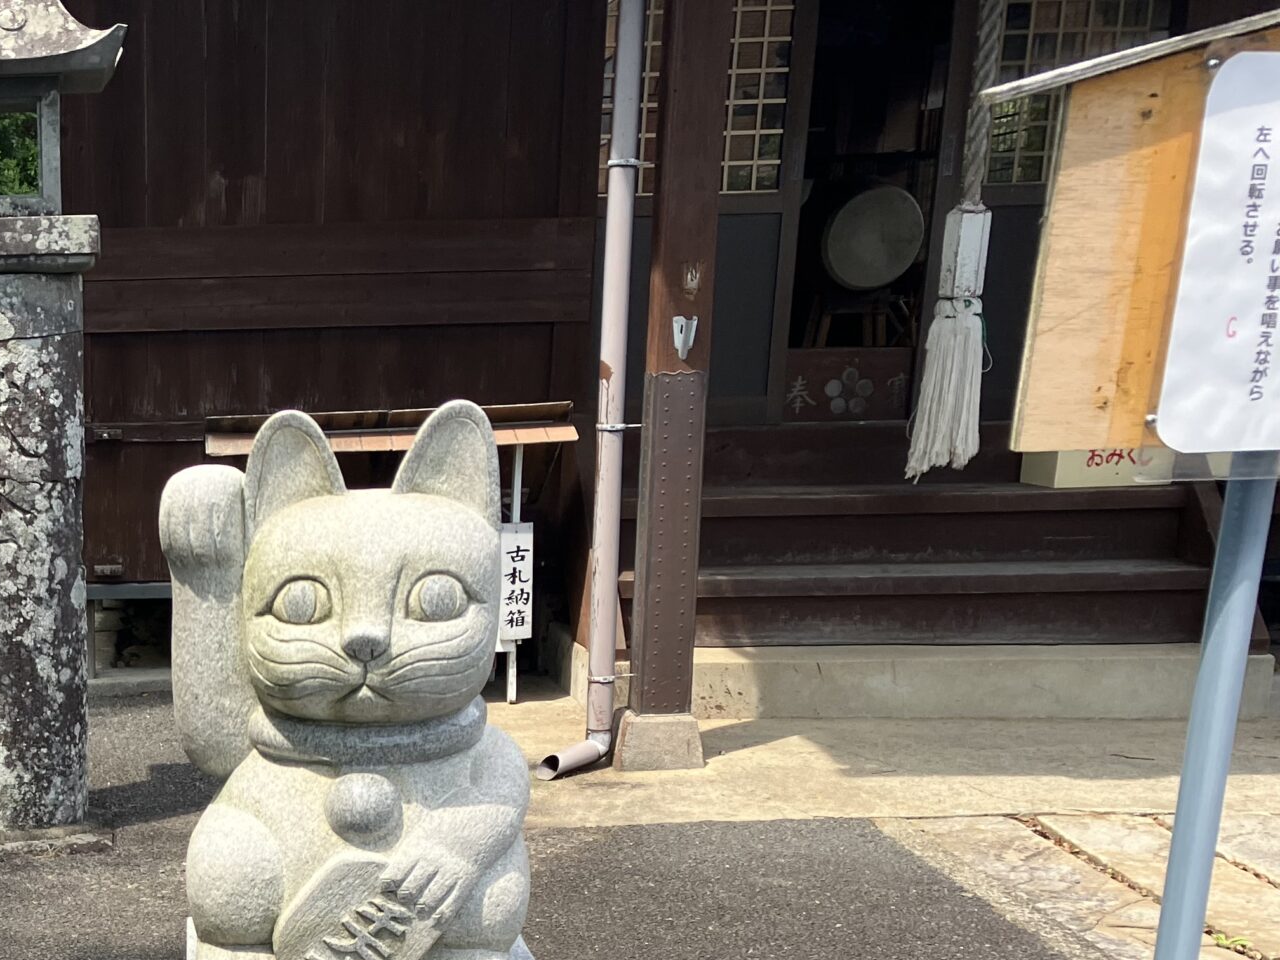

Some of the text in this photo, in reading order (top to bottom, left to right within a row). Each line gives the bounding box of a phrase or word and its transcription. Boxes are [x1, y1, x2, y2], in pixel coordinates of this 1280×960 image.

[1239, 125, 1272, 265] 左へ回転させる。
[1249, 222, 1280, 402] い事を唱えながら
[504, 545, 531, 629] 古札納箱
